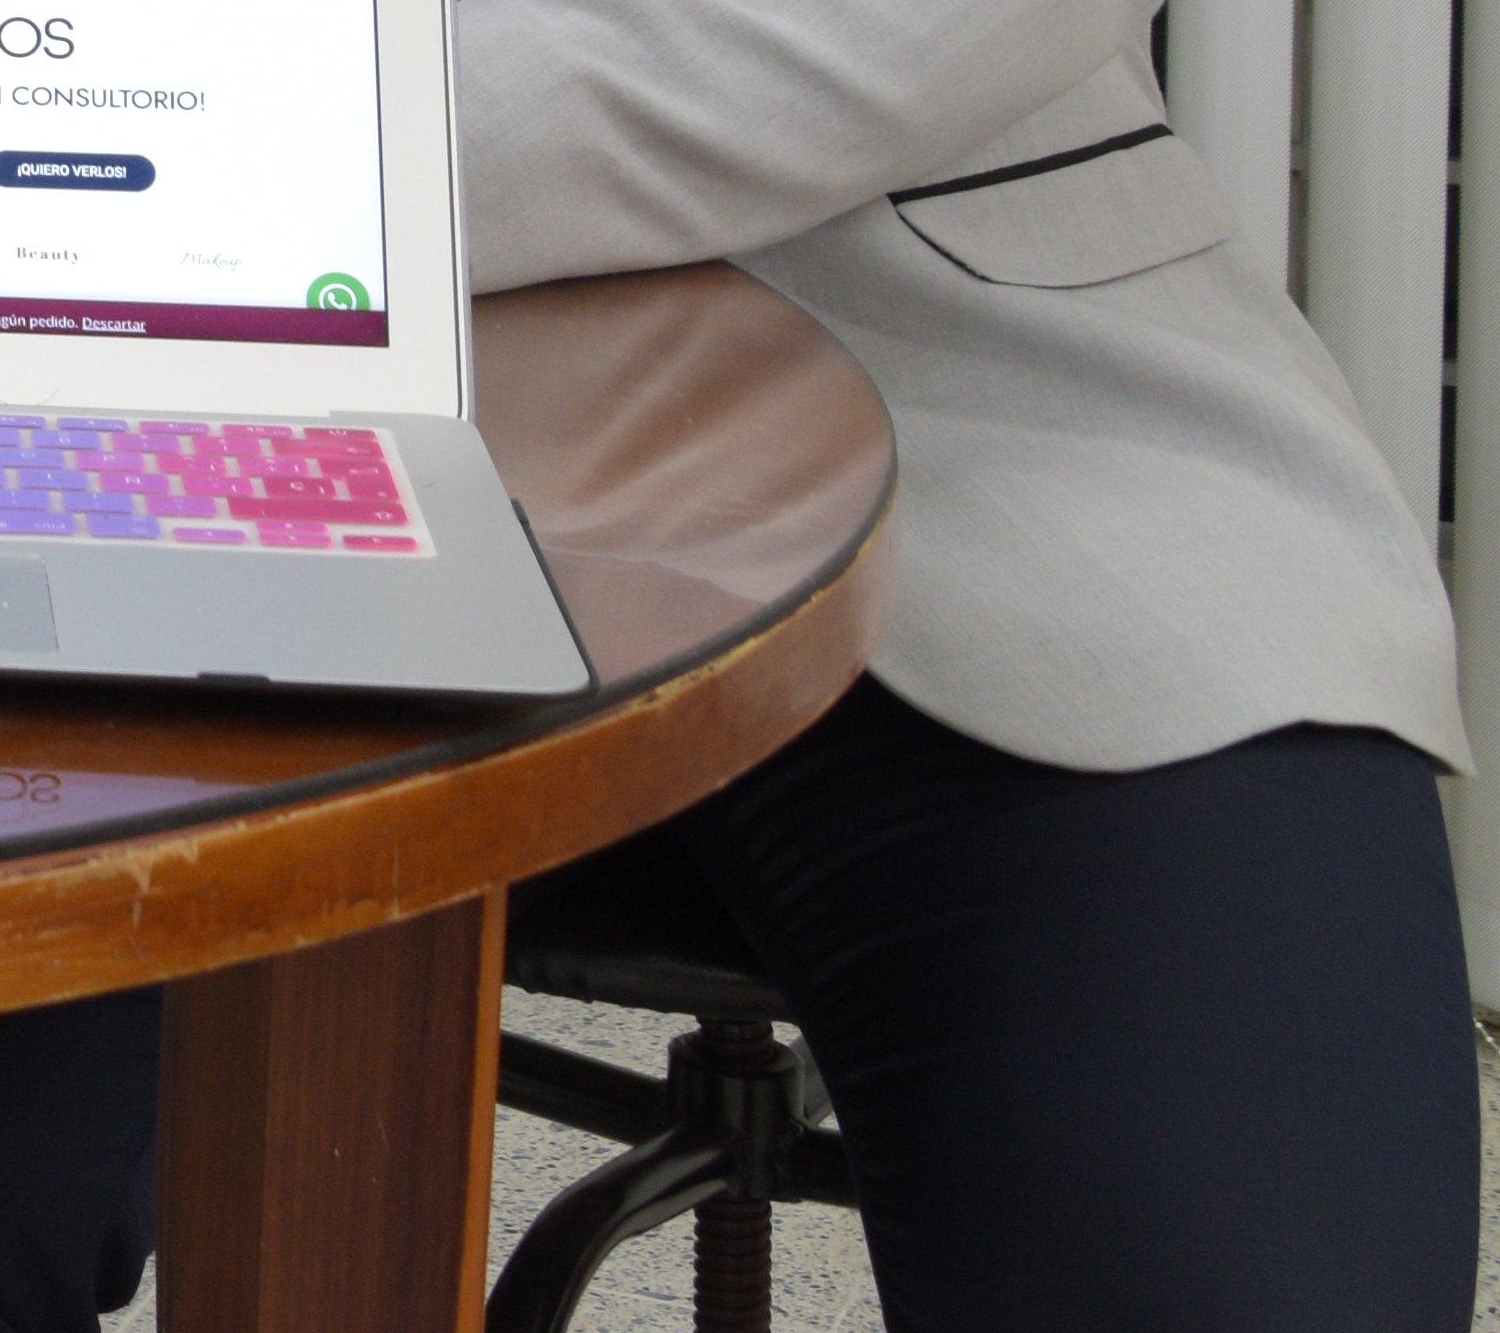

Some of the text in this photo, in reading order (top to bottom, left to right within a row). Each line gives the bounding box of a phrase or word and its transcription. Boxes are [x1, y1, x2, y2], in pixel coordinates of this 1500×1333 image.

[12, 86, 204, 110] CONSULTORIO!
[17, 162, 126, 178] ¡QUIERO VERLOS!
[17, 247, 80, 265] Beauty
[179, 252, 242, 271] Makeup
[29, 315, 78, 329] pedido.
[82, 317, 146, 332] Descartar
